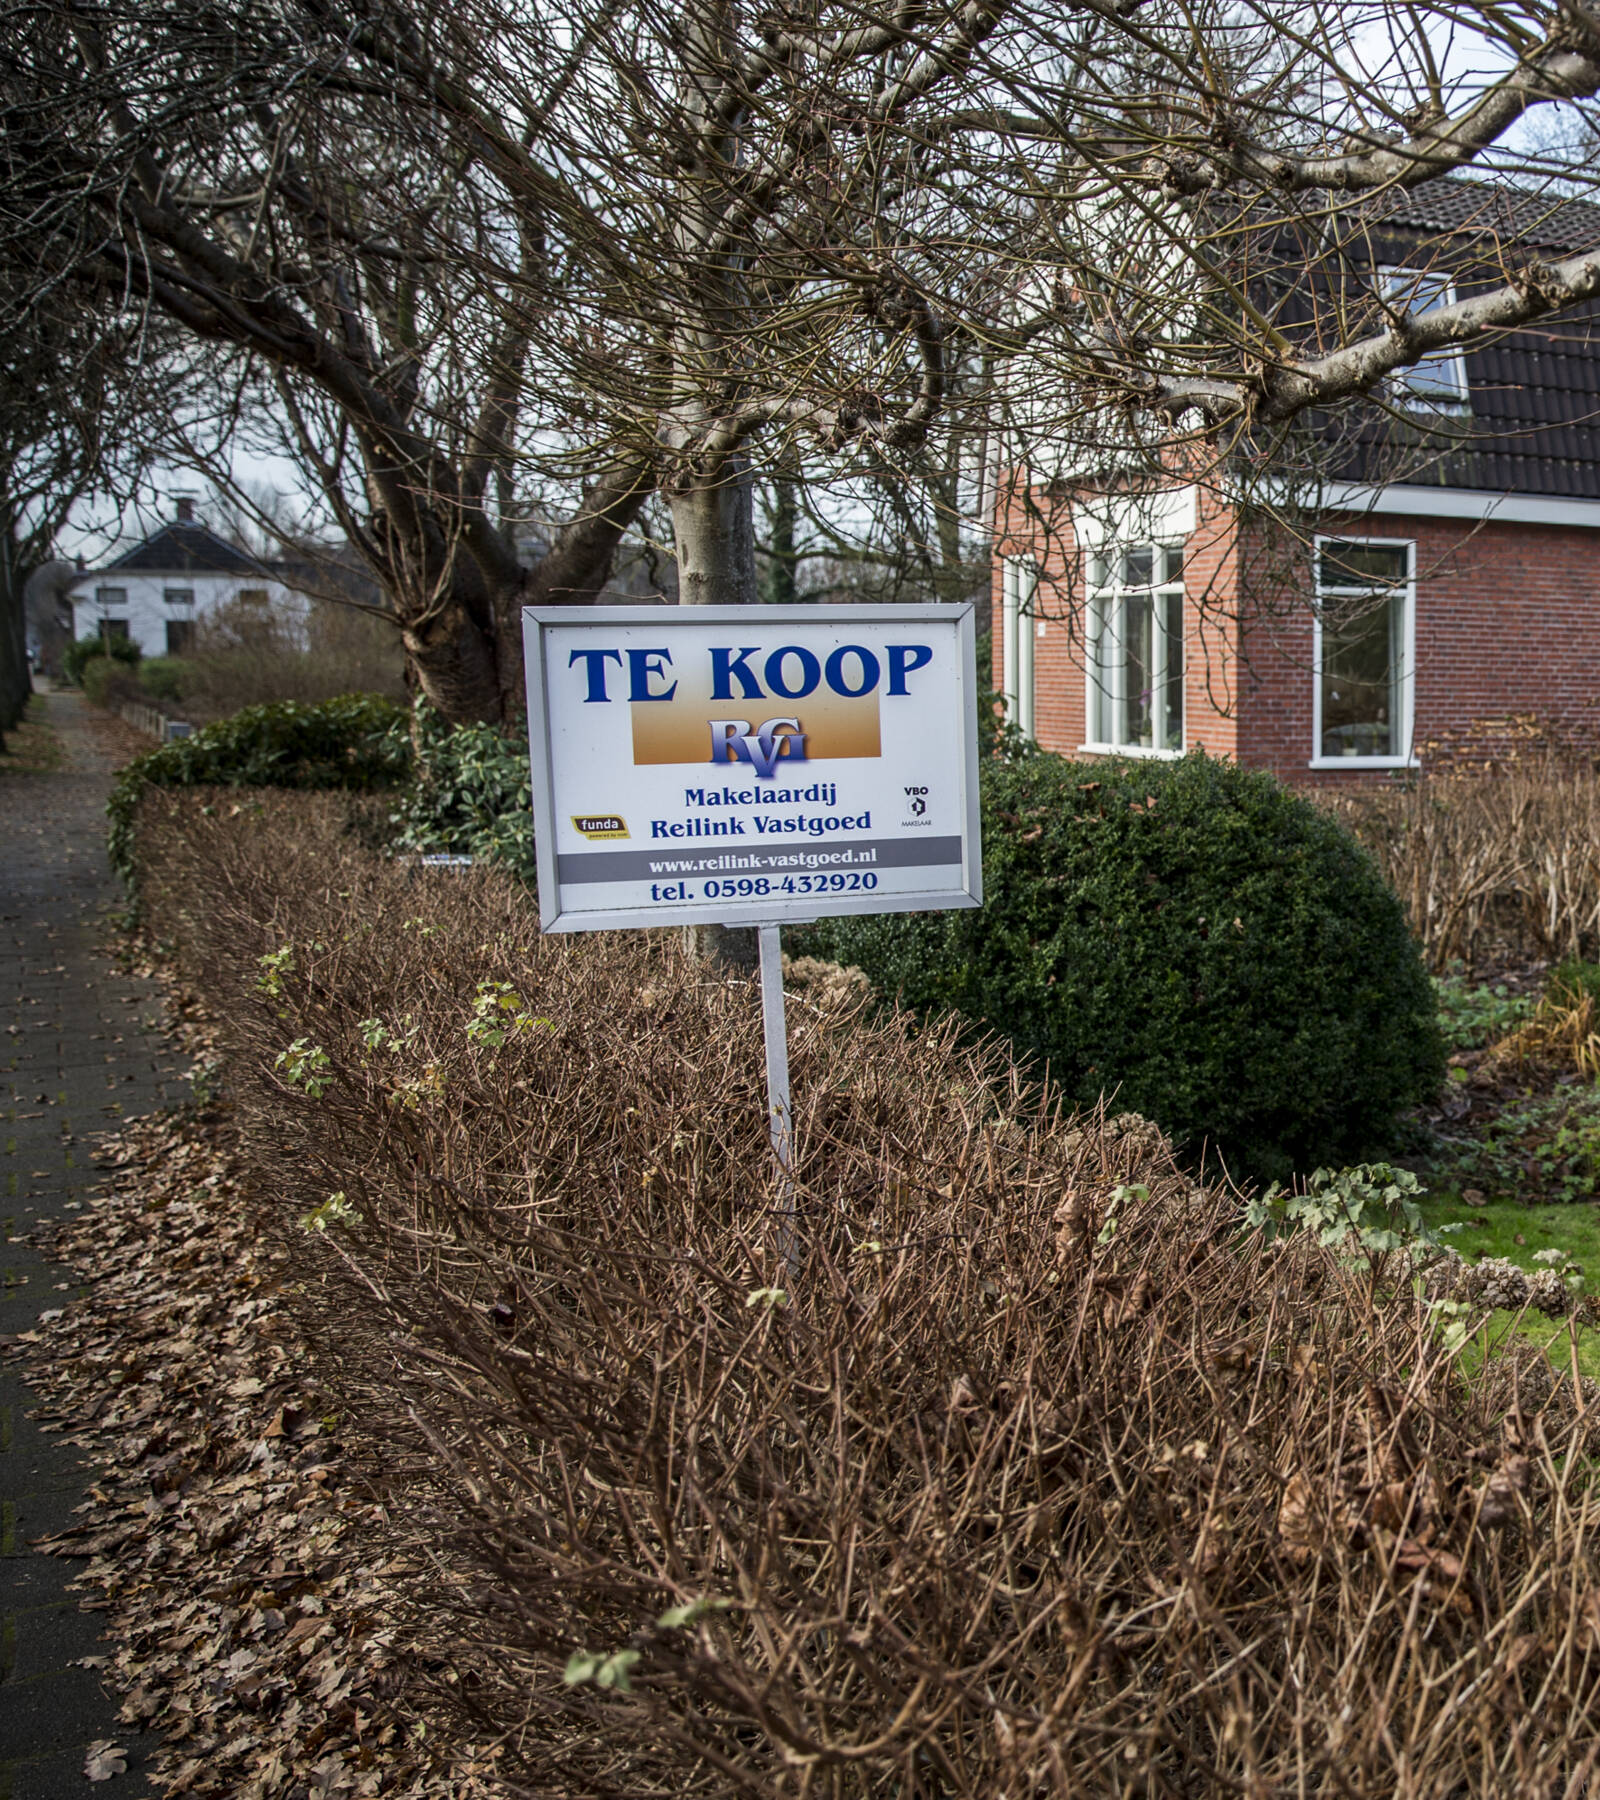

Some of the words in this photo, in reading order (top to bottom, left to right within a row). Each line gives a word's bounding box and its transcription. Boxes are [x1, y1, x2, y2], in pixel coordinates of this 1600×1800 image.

[568, 648, 678, 703] TE
[709, 645, 933, 700] KOOP
[685, 783, 837, 807] Makelaardij
[904, 786, 929, 796] VBO
[581, 818, 619, 830] funda
[651, 817, 746, 839] Reilink
[753, 811, 872, 836] Vastgoed
[649, 848, 877, 873] www.reilink-vastgoed.nl
[651, 882, 694, 901] tel.
[703, 872, 878, 898] 0598-432920
